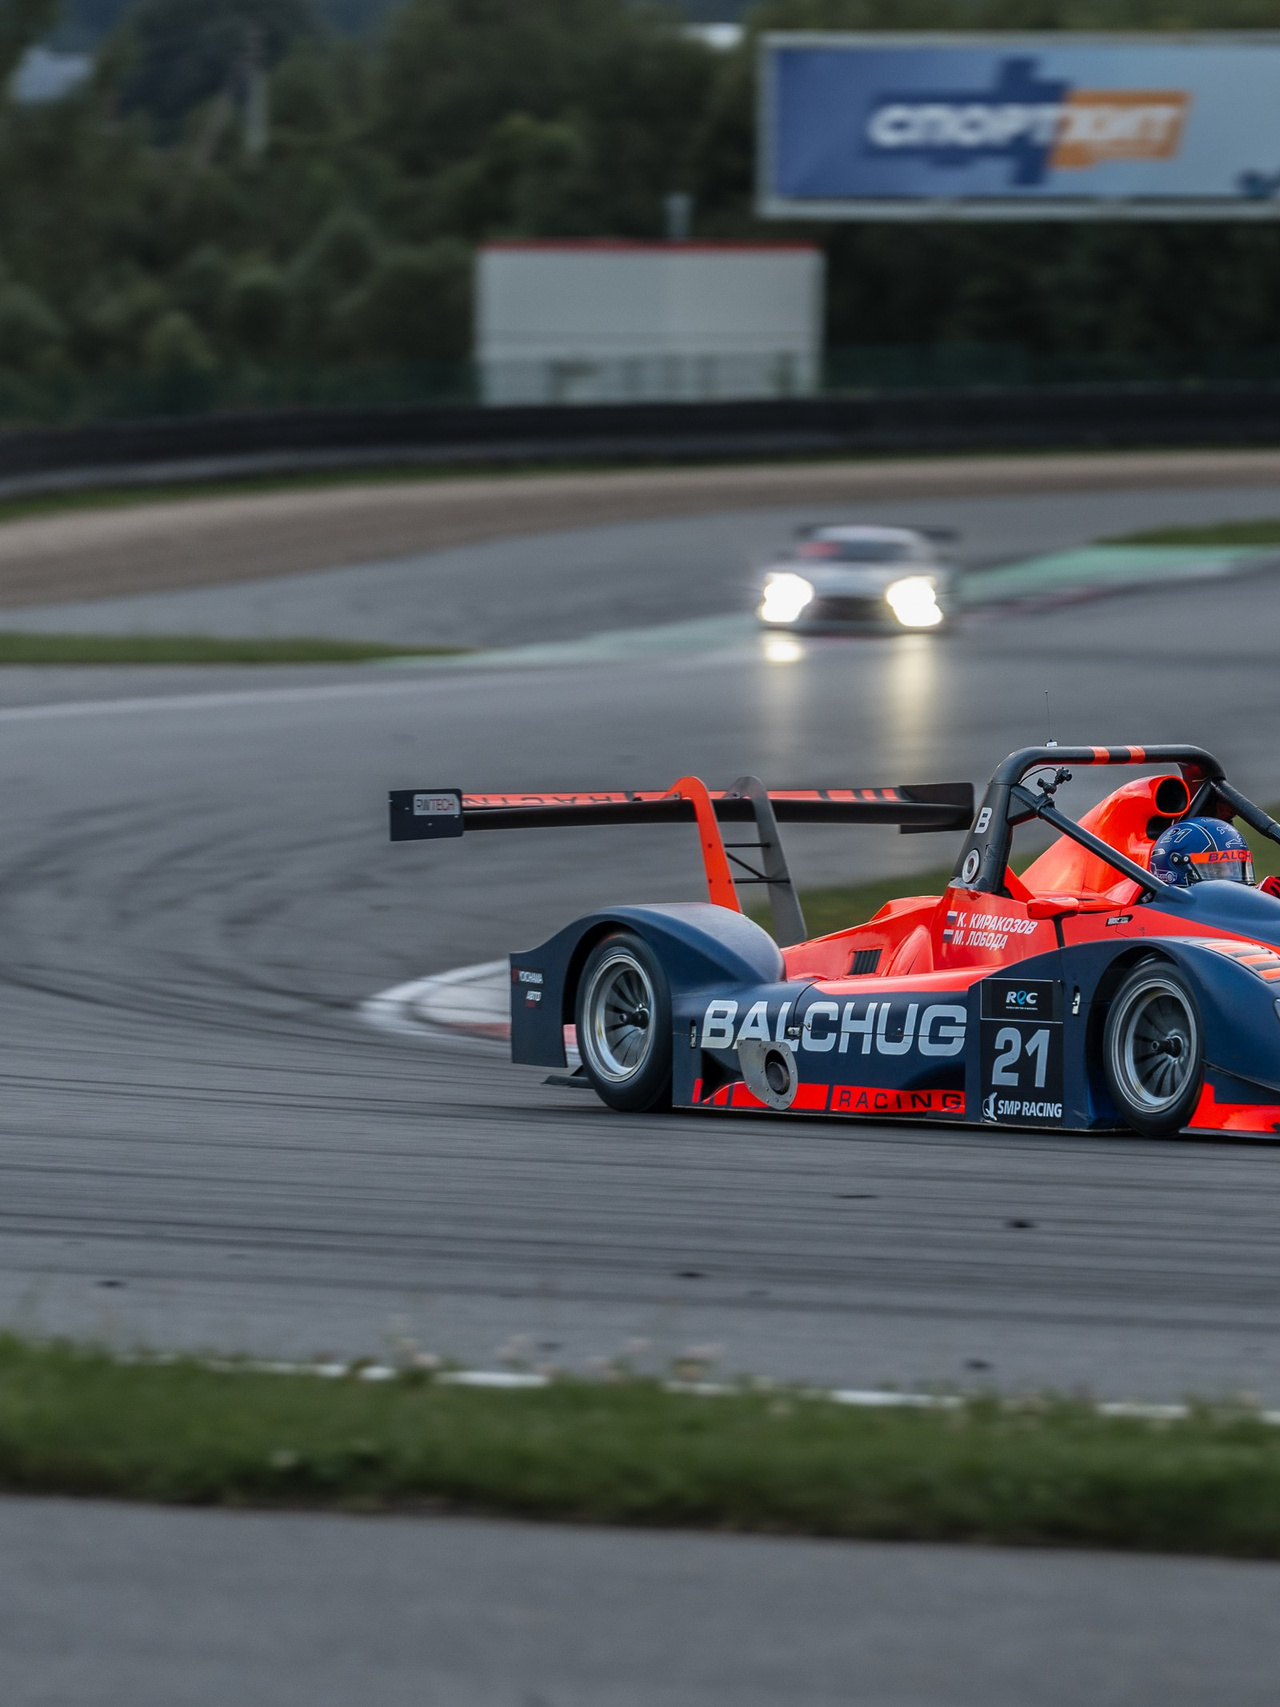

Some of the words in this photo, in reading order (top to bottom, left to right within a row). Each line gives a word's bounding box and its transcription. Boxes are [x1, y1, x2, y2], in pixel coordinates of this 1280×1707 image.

[974, 807, 993, 834] B
[970, 913, 1039, 935] КИРАКОЗОВ
[966, 931, 1008, 950] ЛОБОДА
[700, 999, 968, 1057] BALCHUG
[991, 1026, 1050, 1088] 21
[838, 1090, 963, 1110] RACING
[997, 1099, 1021, 1116] SMP
[1022, 1101, 1063, 1118] RACING
